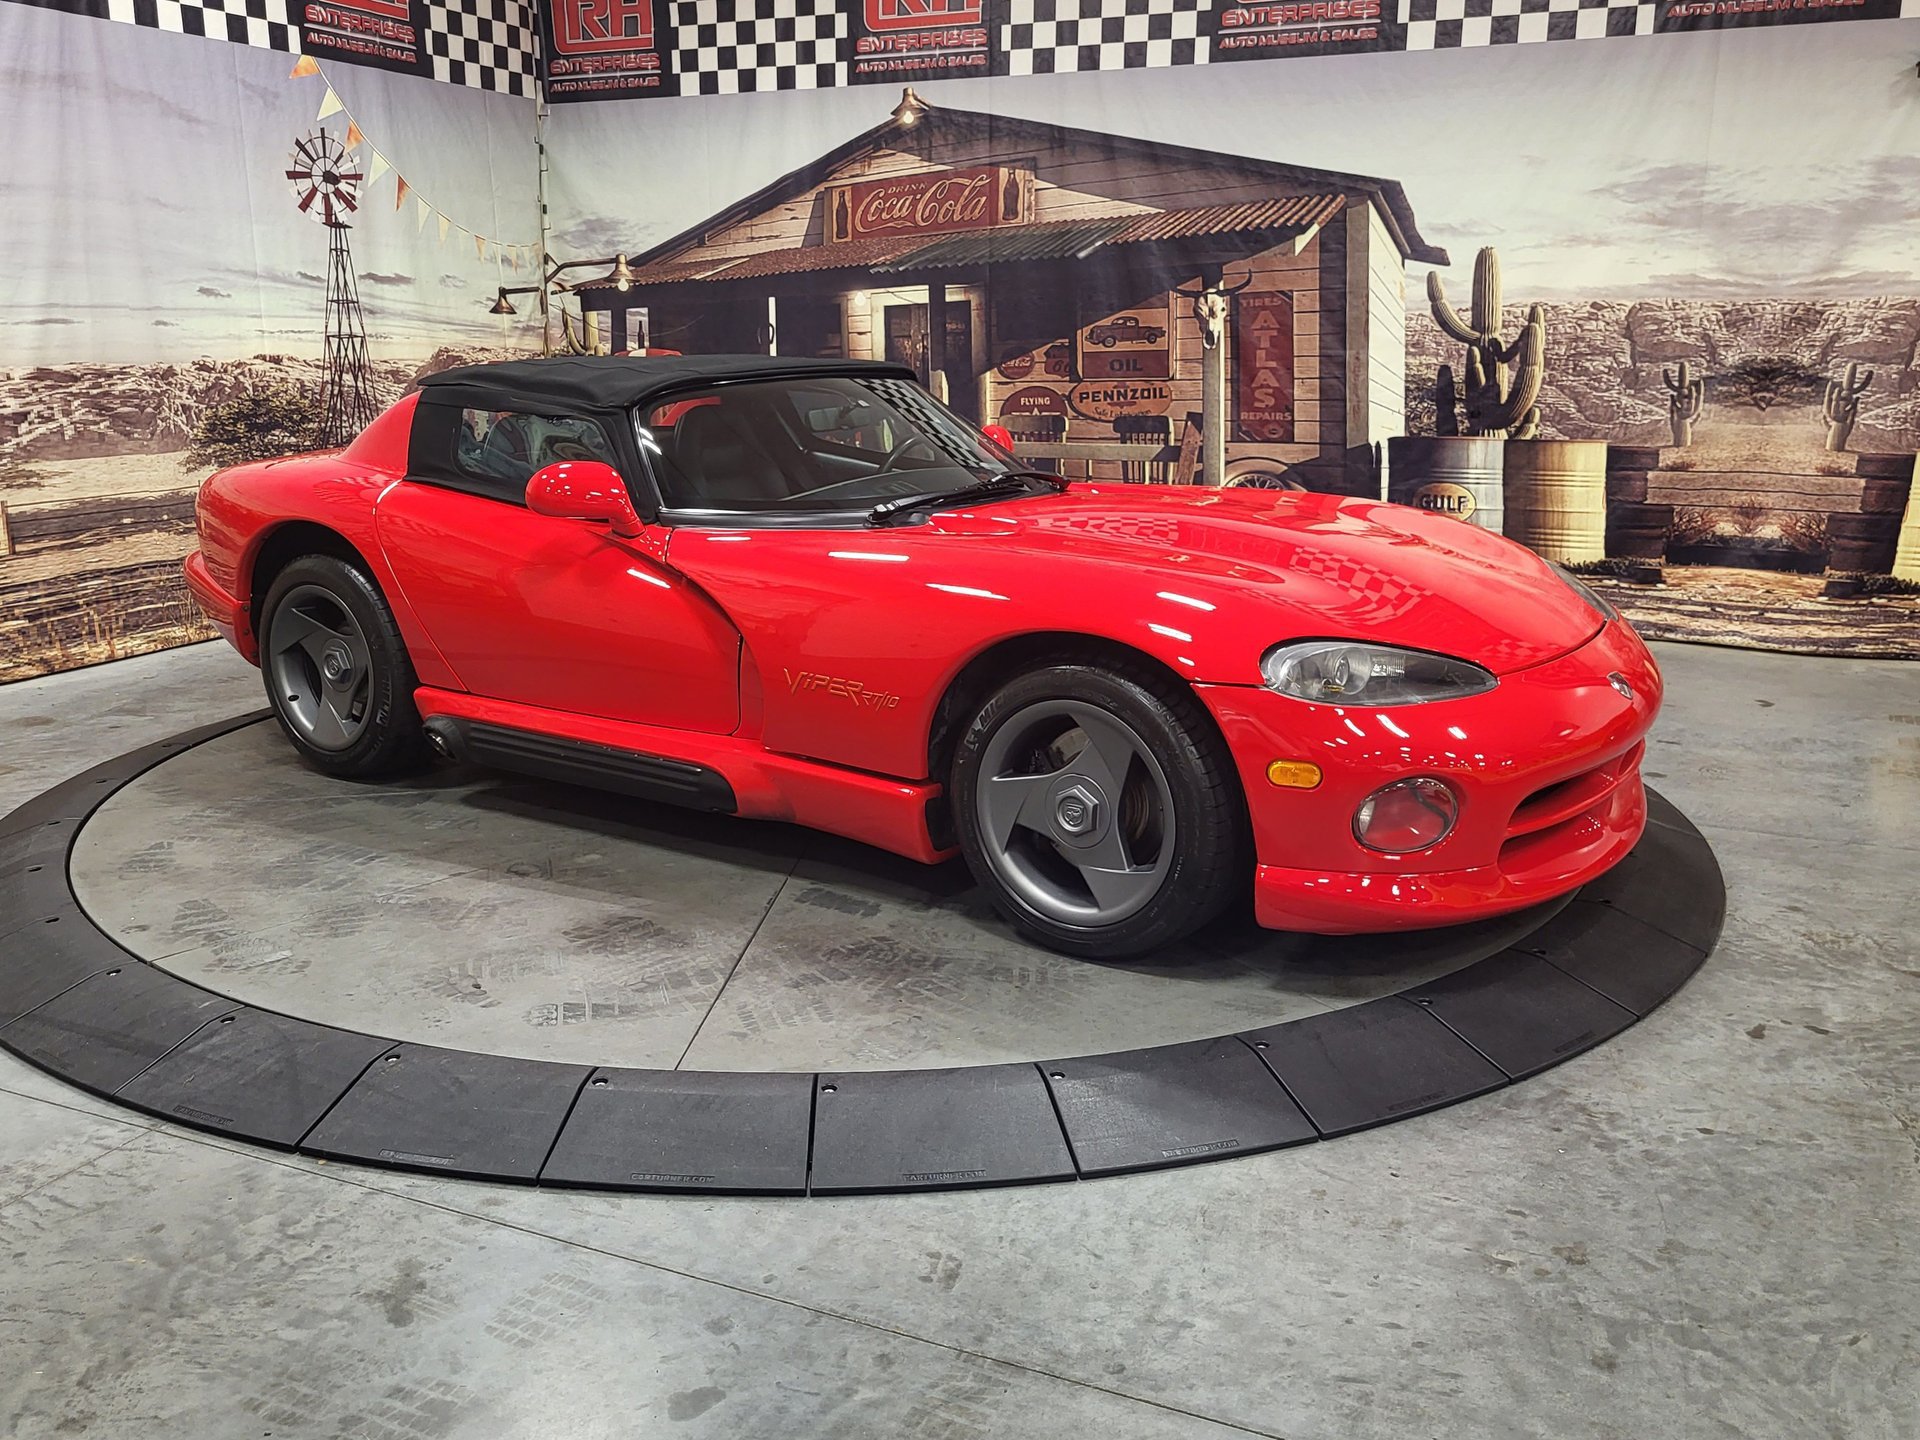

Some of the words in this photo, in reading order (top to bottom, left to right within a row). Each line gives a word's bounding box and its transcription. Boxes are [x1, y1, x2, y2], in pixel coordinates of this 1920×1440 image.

[1221, 0, 1381, 27] ENTERPRISES
[1666, 4, 1715, 17] AUTO
[1716, 0, 1790, 14] MUSEUM
[305, 4, 416, 43] ENTERPRISES
[307, 32, 336, 46] AUTO
[856, 28, 988, 53] ENTERPRISES
[1219, 36, 1257, 50] AUTO
[1258, 31, 1318, 47] MUSEUM
[1319, 30, 1330, 42] &
[1331, 27, 1378, 41] SALES
[550, 53, 660, 75] ENTERPRISES
[855, 60, 887, 74] AUTO
[888, 57, 937, 73] MUSEUM
[938, 57, 947, 67] &
[947, 54, 987, 66] SALES
[550, 81, 577, 93] AUTO
[888, 181, 928, 195] DRINK
[1240, 296, 1282, 307] TIRES
[1109, 358, 1143, 372] OIL
[1251, 310, 1281, 408] ATLAS
[1020, 397, 1051, 406] FLYING
[1079, 387, 1169, 404] PENNZOIL
[1240, 411, 1292, 421] REPAIRS
[1420, 494, 1467, 514] GULF
